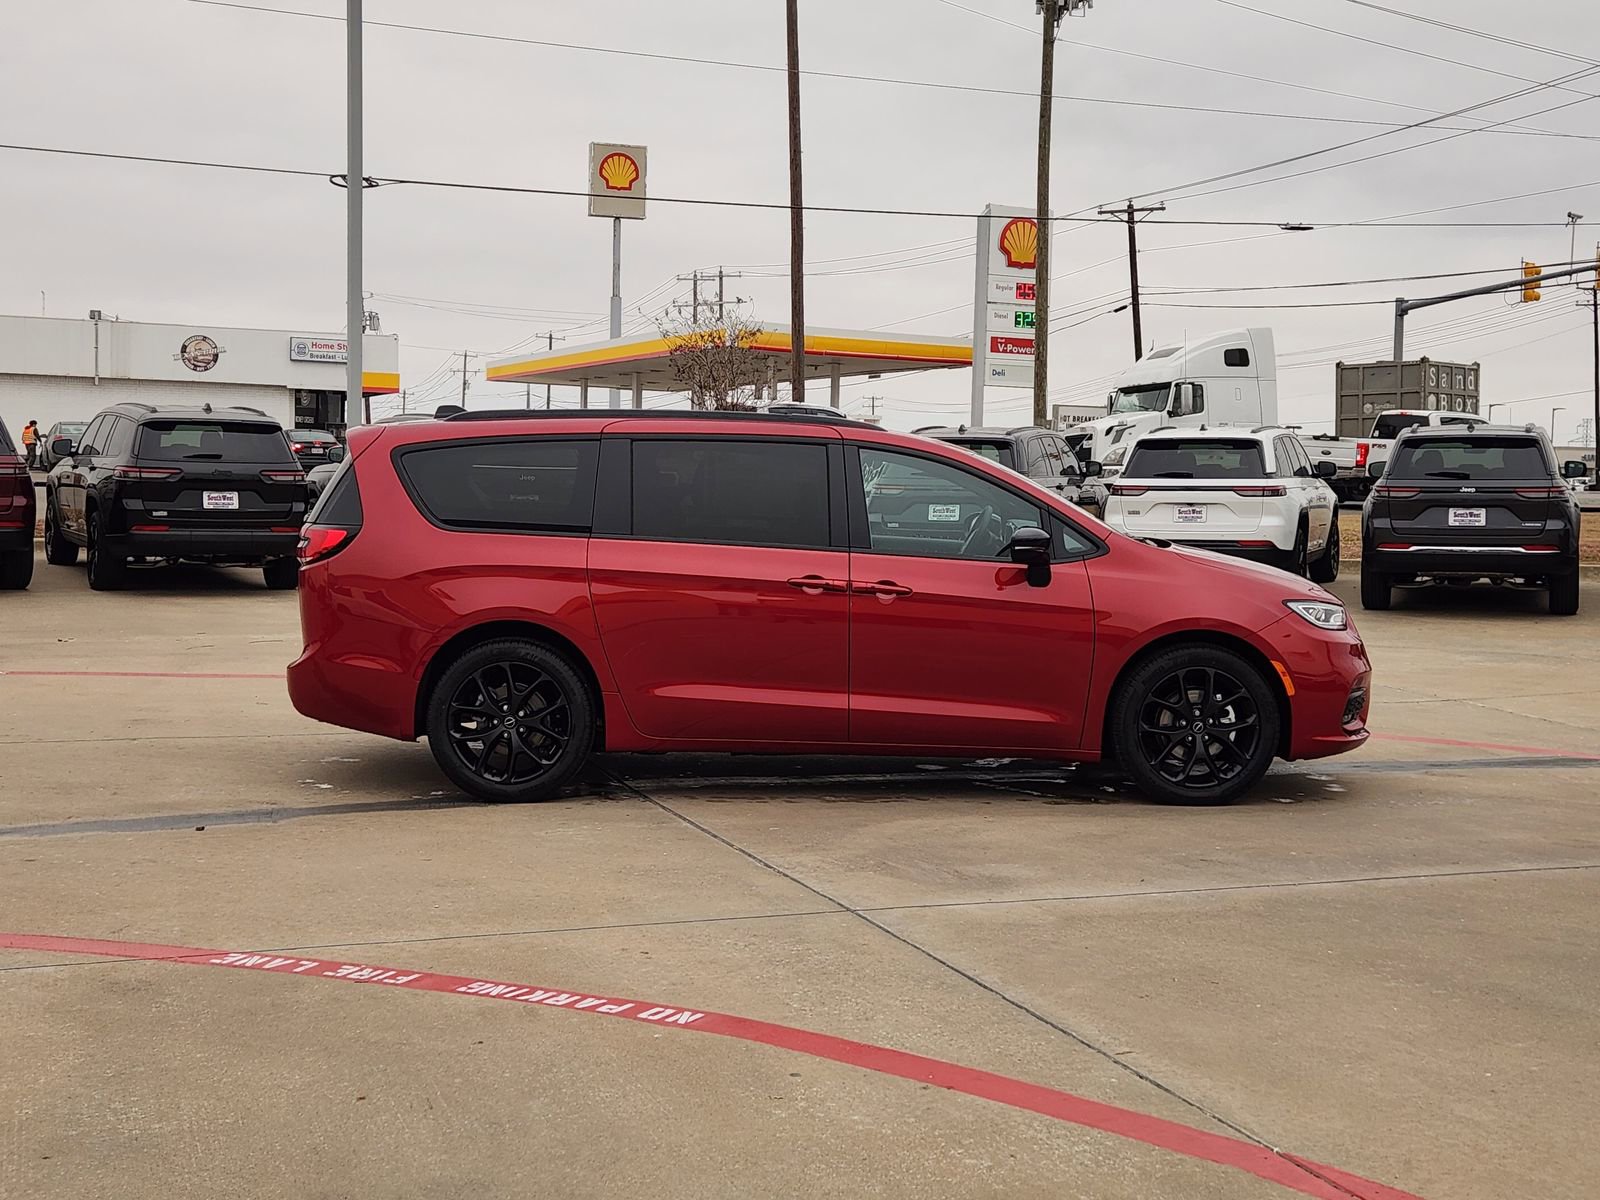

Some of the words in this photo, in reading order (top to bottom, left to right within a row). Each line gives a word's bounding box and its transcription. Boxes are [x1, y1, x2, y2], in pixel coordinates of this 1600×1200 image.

[995, 283, 1014, 292] Regular
[311, 341, 335, 350] Home
[309, 352, 337, 360] Breakfast
[992, 369, 1006, 377] Deli
[1429, 367, 1475, 390] Sand
[1440, 393, 1473, 413] Box
[209, 952, 320, 973] LANE
[323, 965, 423, 984] FIRE
[456, 981, 636, 1014] PARKING
[637, 1006, 704, 1025] NO
